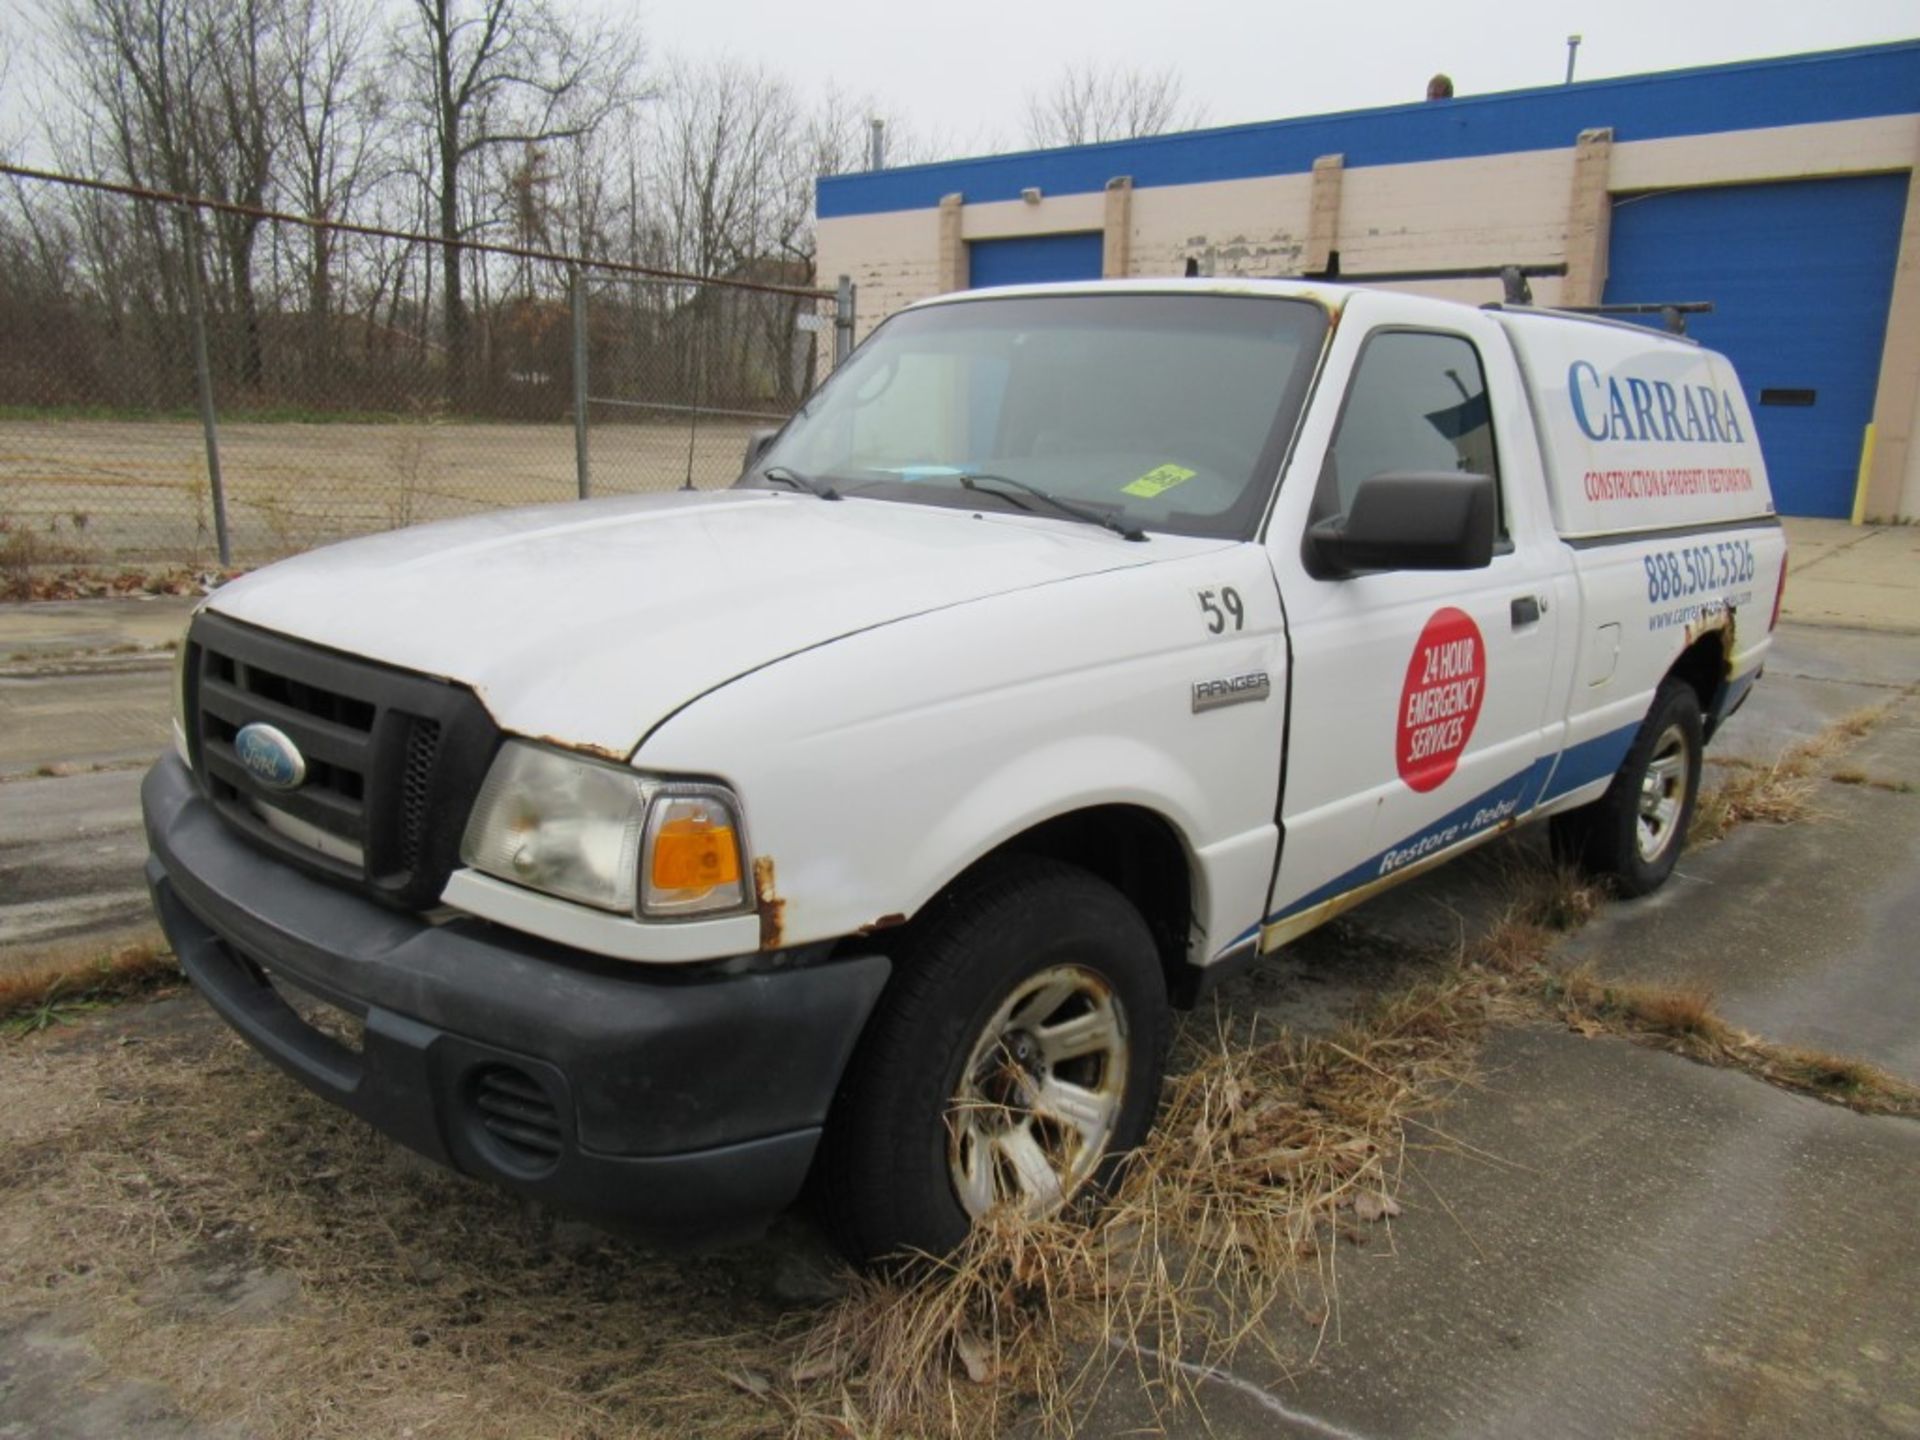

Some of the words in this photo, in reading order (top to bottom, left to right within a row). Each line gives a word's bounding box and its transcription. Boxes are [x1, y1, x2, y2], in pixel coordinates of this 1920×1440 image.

[1568, 360, 1744, 443] CARRARA
[1584, 471, 1659, 501] CONSTRUCTION
[1644, 541, 1754, 603] 888.502.5326
[1198, 587, 1243, 634] 59
[1197, 672, 1269, 698] RANGER
[1422, 646, 1438, 685] 24
[1440, 637, 1475, 679] HOUR
[1406, 677, 1480, 728] EMERGENCY
[1408, 716, 1466, 763] SERVICES
[1379, 825, 1459, 875] Restore
